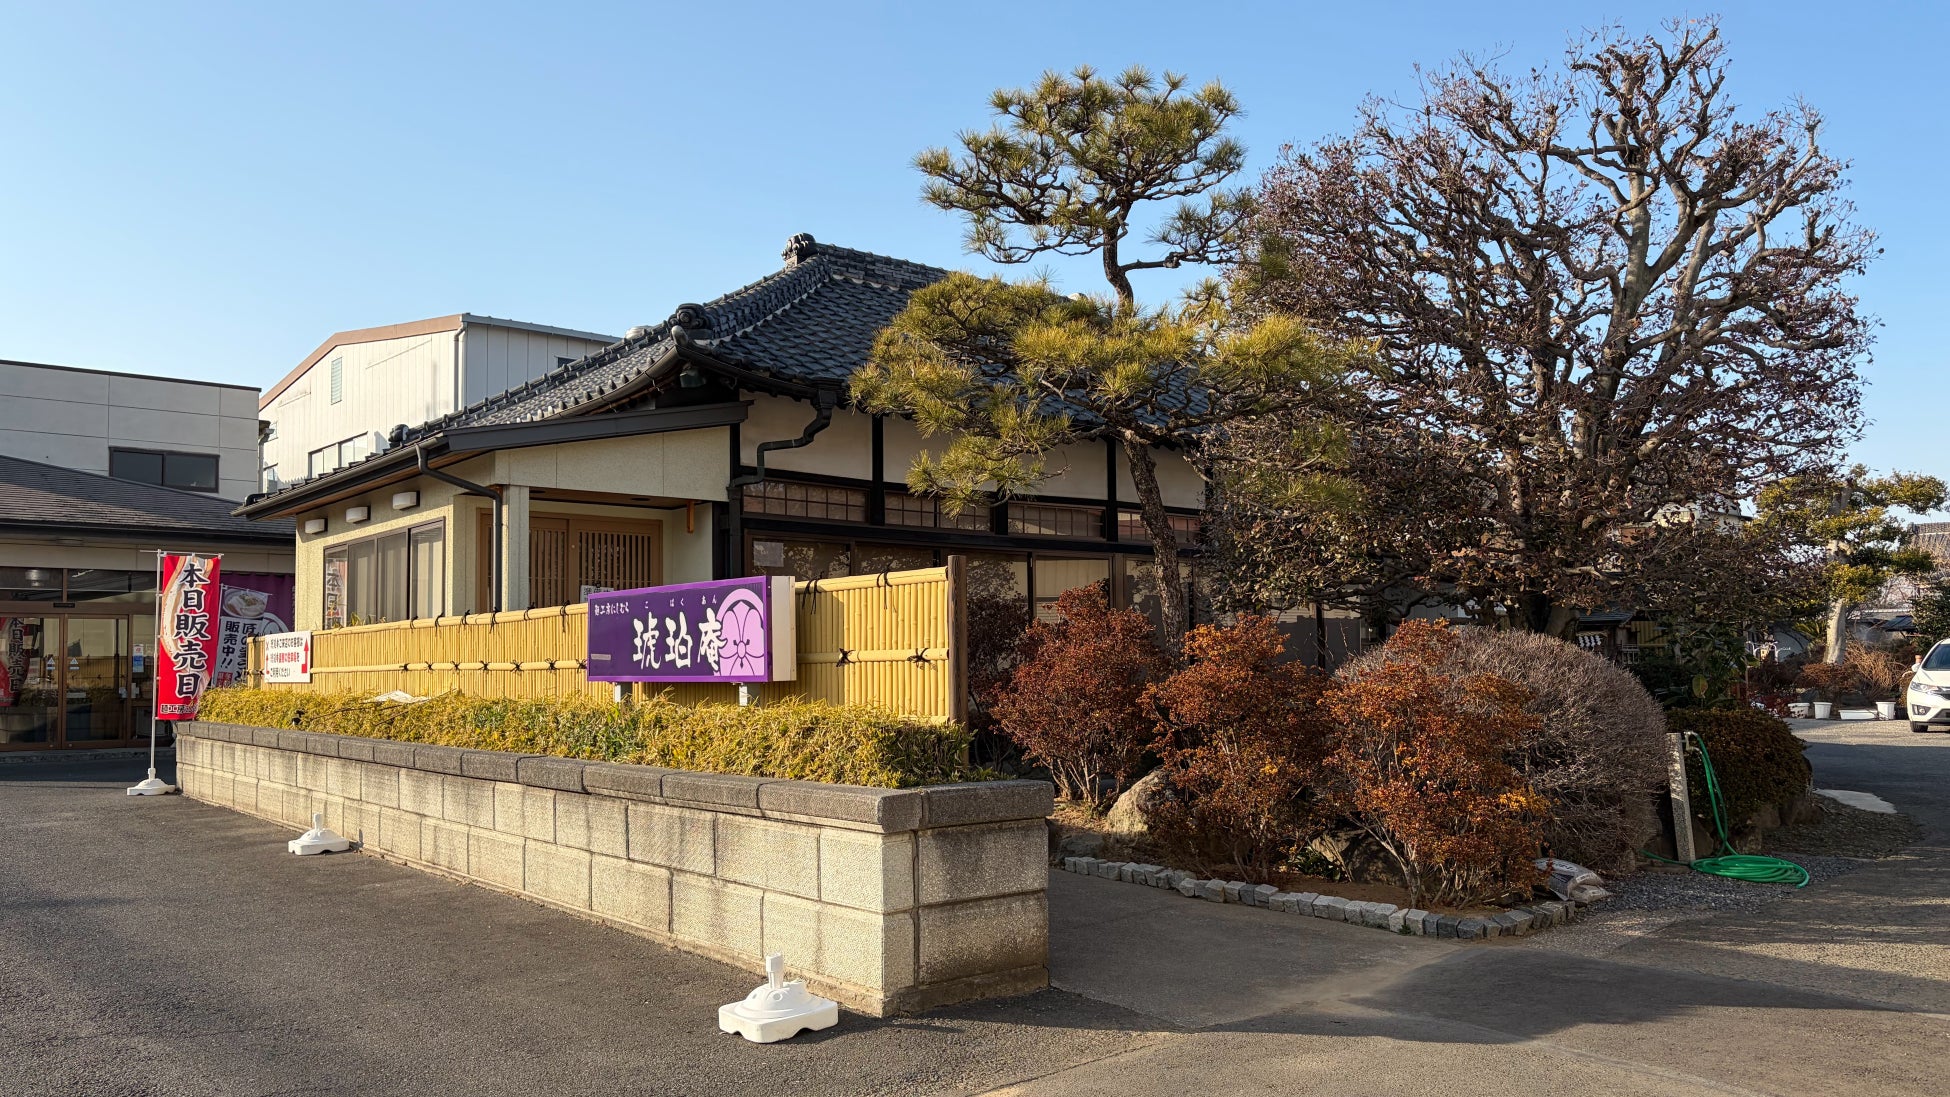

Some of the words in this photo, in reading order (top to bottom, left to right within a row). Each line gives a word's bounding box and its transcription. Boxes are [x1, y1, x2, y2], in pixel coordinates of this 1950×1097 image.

[173, 563, 211, 699] 本日販売日
[632, 607, 728, 672] 琥珀庵
